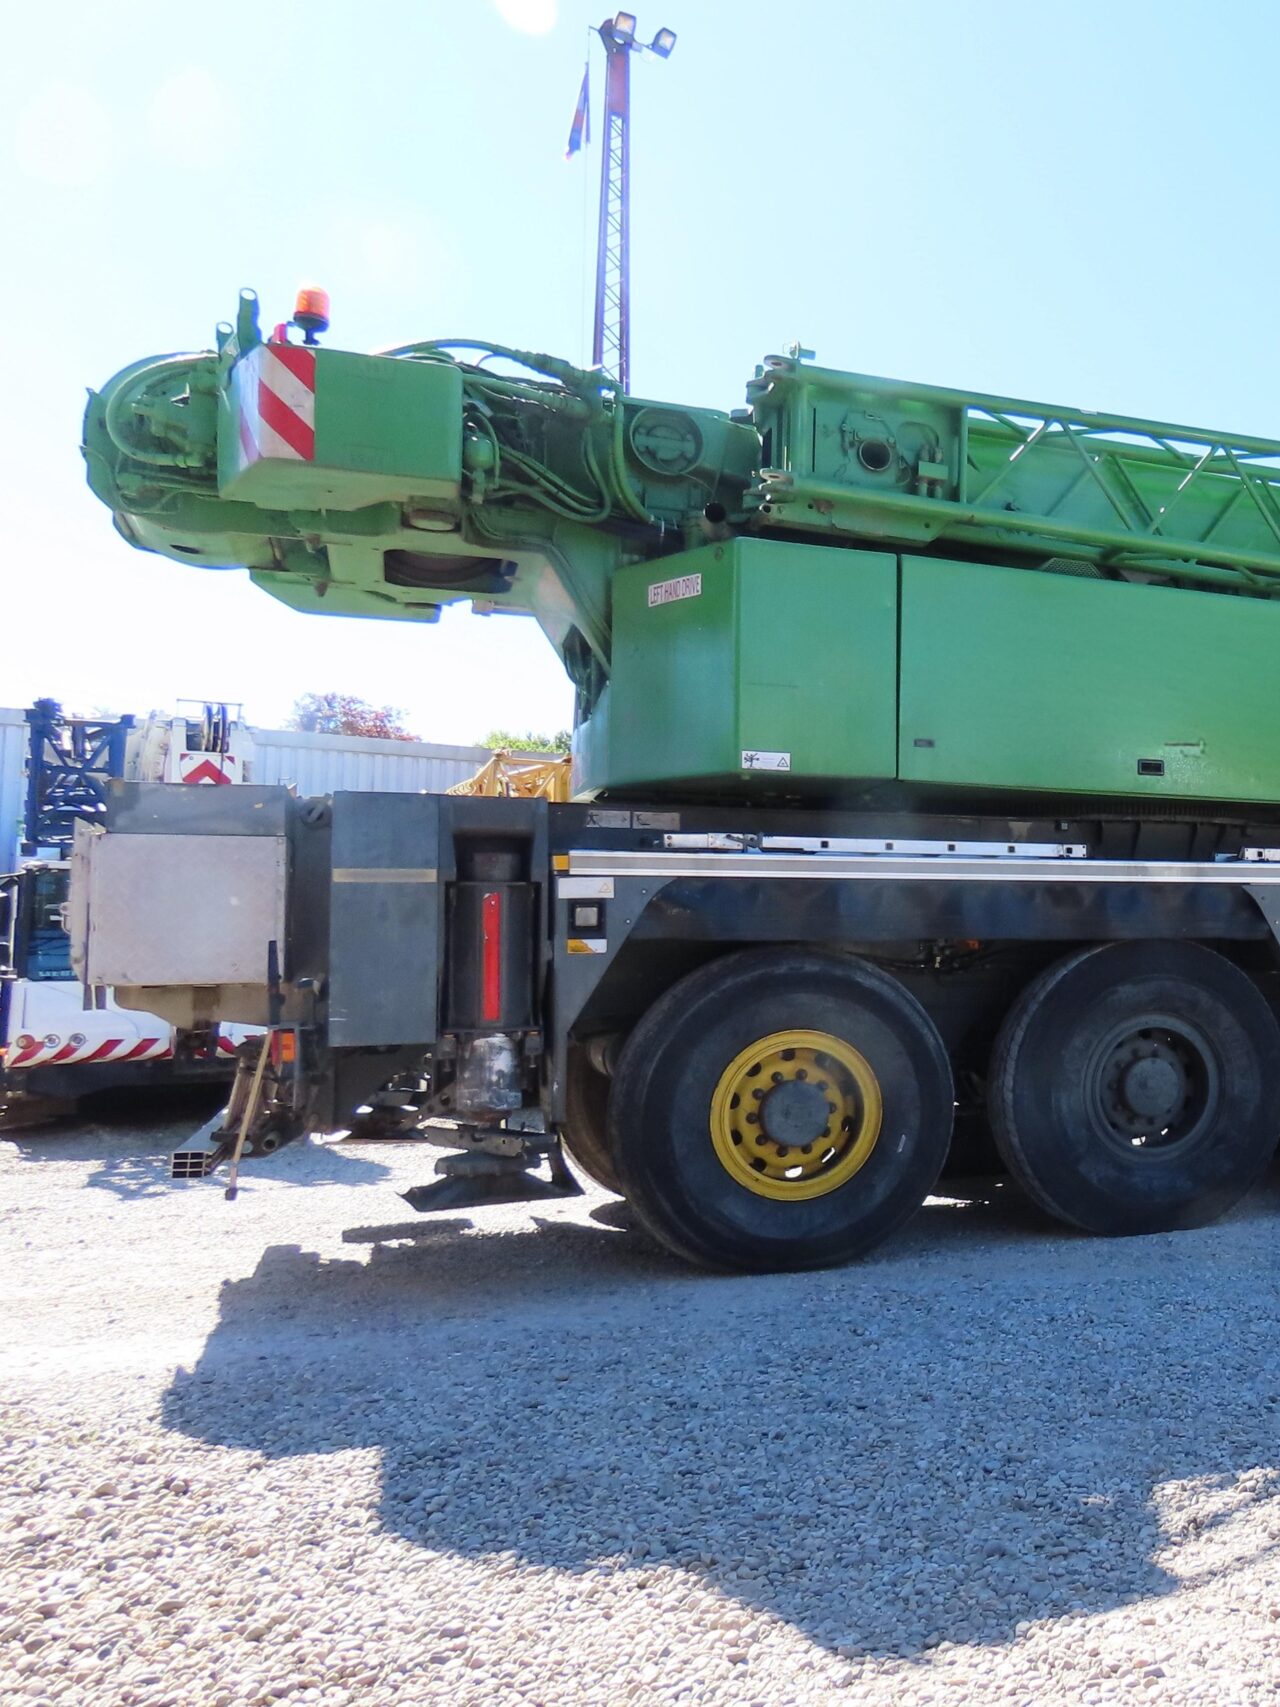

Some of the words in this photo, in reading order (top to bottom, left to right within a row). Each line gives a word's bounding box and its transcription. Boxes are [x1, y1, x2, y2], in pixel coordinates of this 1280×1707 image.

[650, 584, 664, 604] LEFT
[664, 580, 681, 601] HAND
[681, 575, 700, 596] DRIVE
